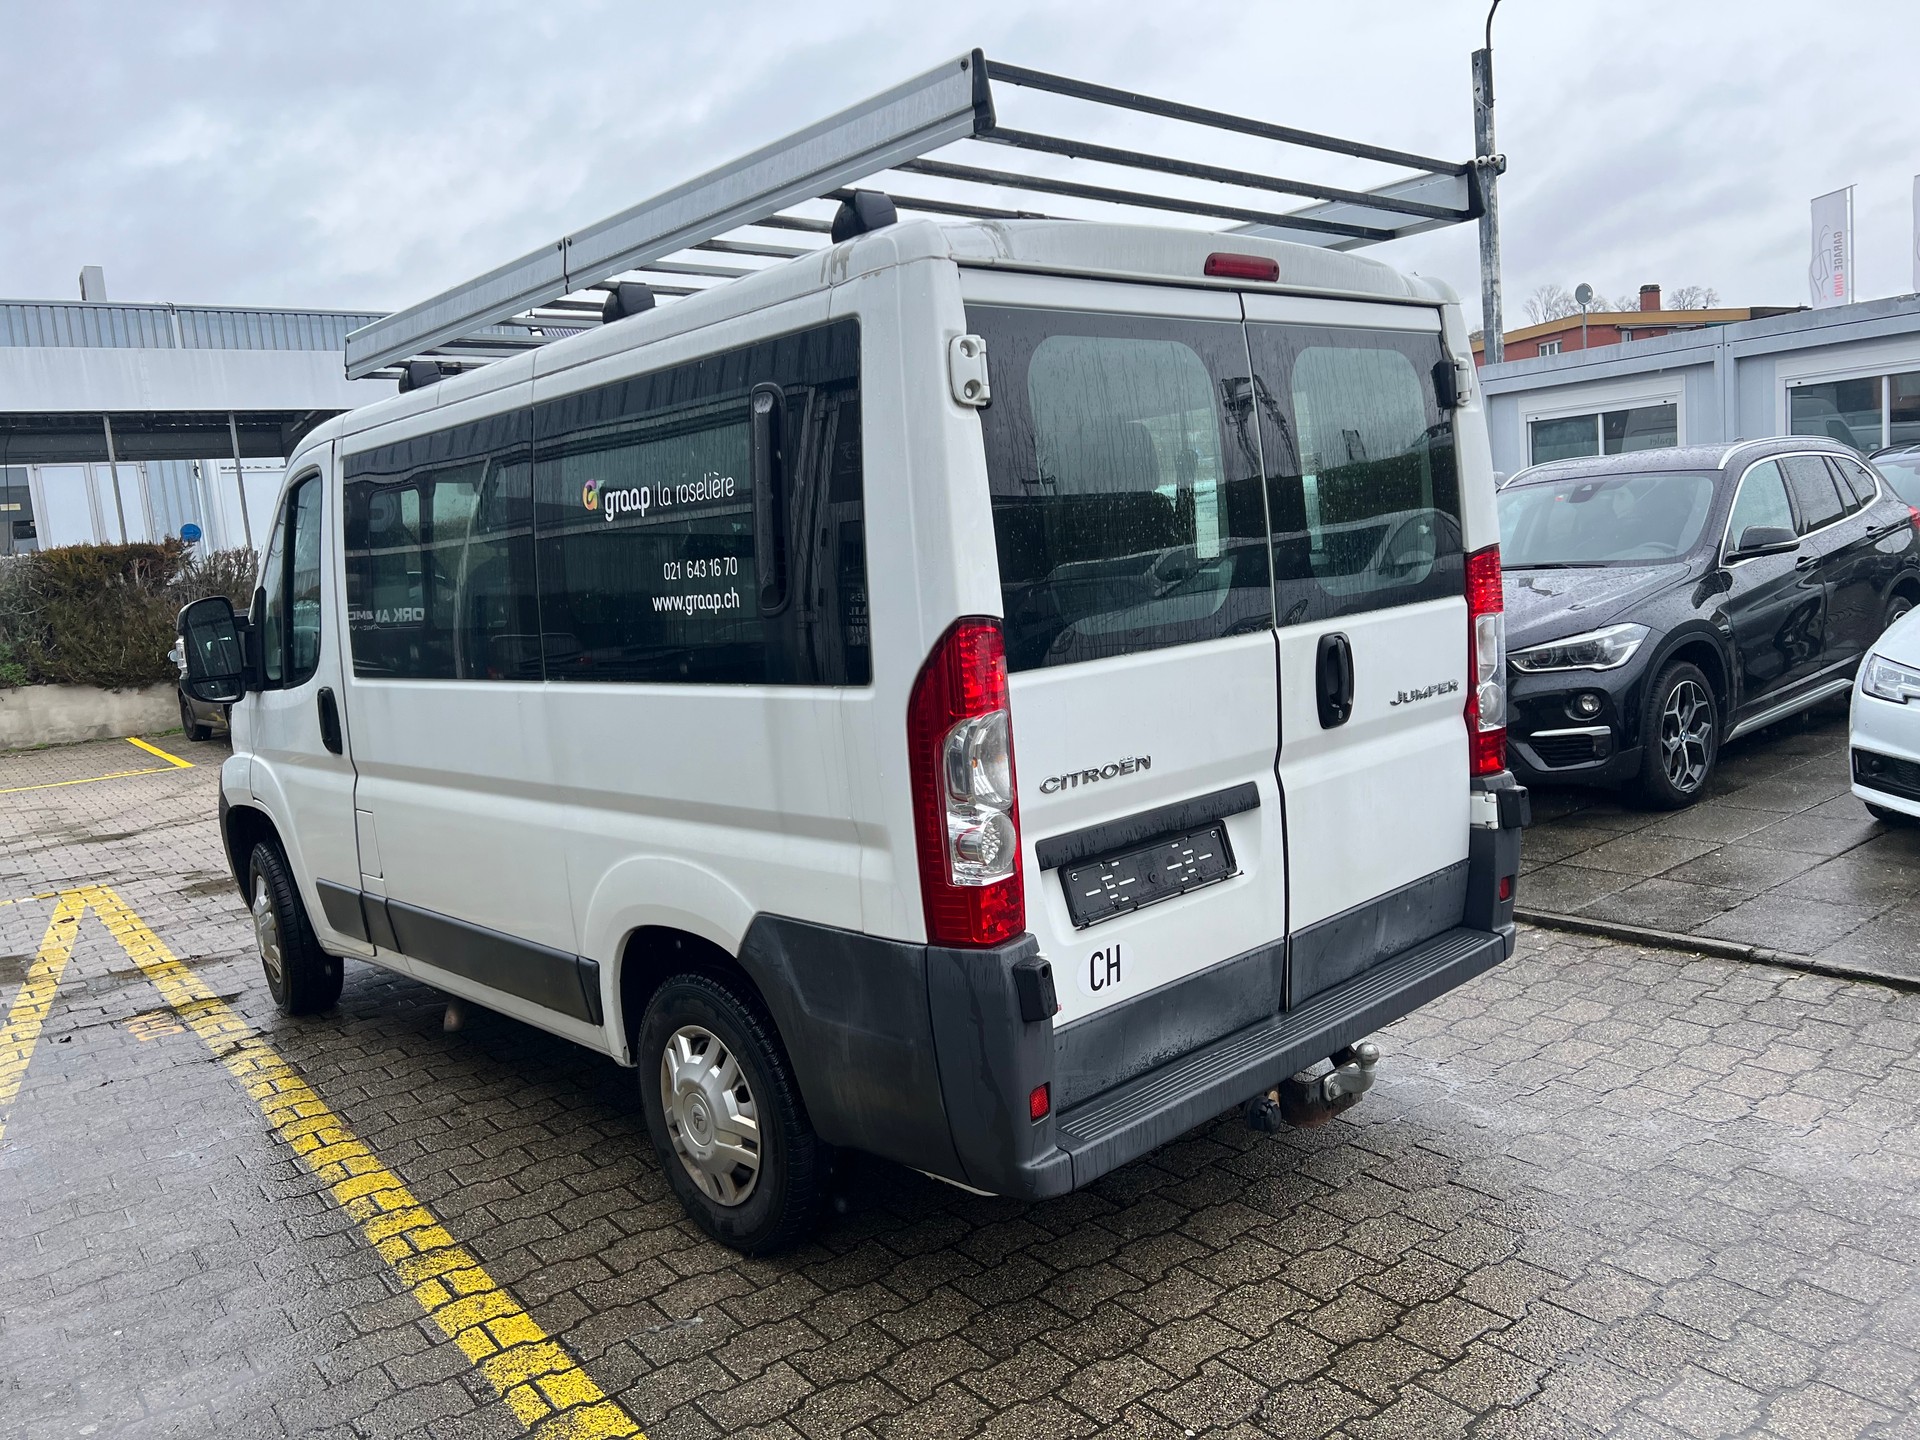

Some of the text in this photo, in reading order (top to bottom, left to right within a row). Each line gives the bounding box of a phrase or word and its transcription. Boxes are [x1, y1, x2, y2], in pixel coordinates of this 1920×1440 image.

[605, 471, 735, 522] graap la roselière
[663, 556, 738, 581] 021 643 16 70
[652, 587, 740, 616] www.graap.ch
[1389, 679, 1458, 706] JUMPER
[1039, 755, 1151, 794] CITROËN
[1089, 944, 1121, 991] CH
